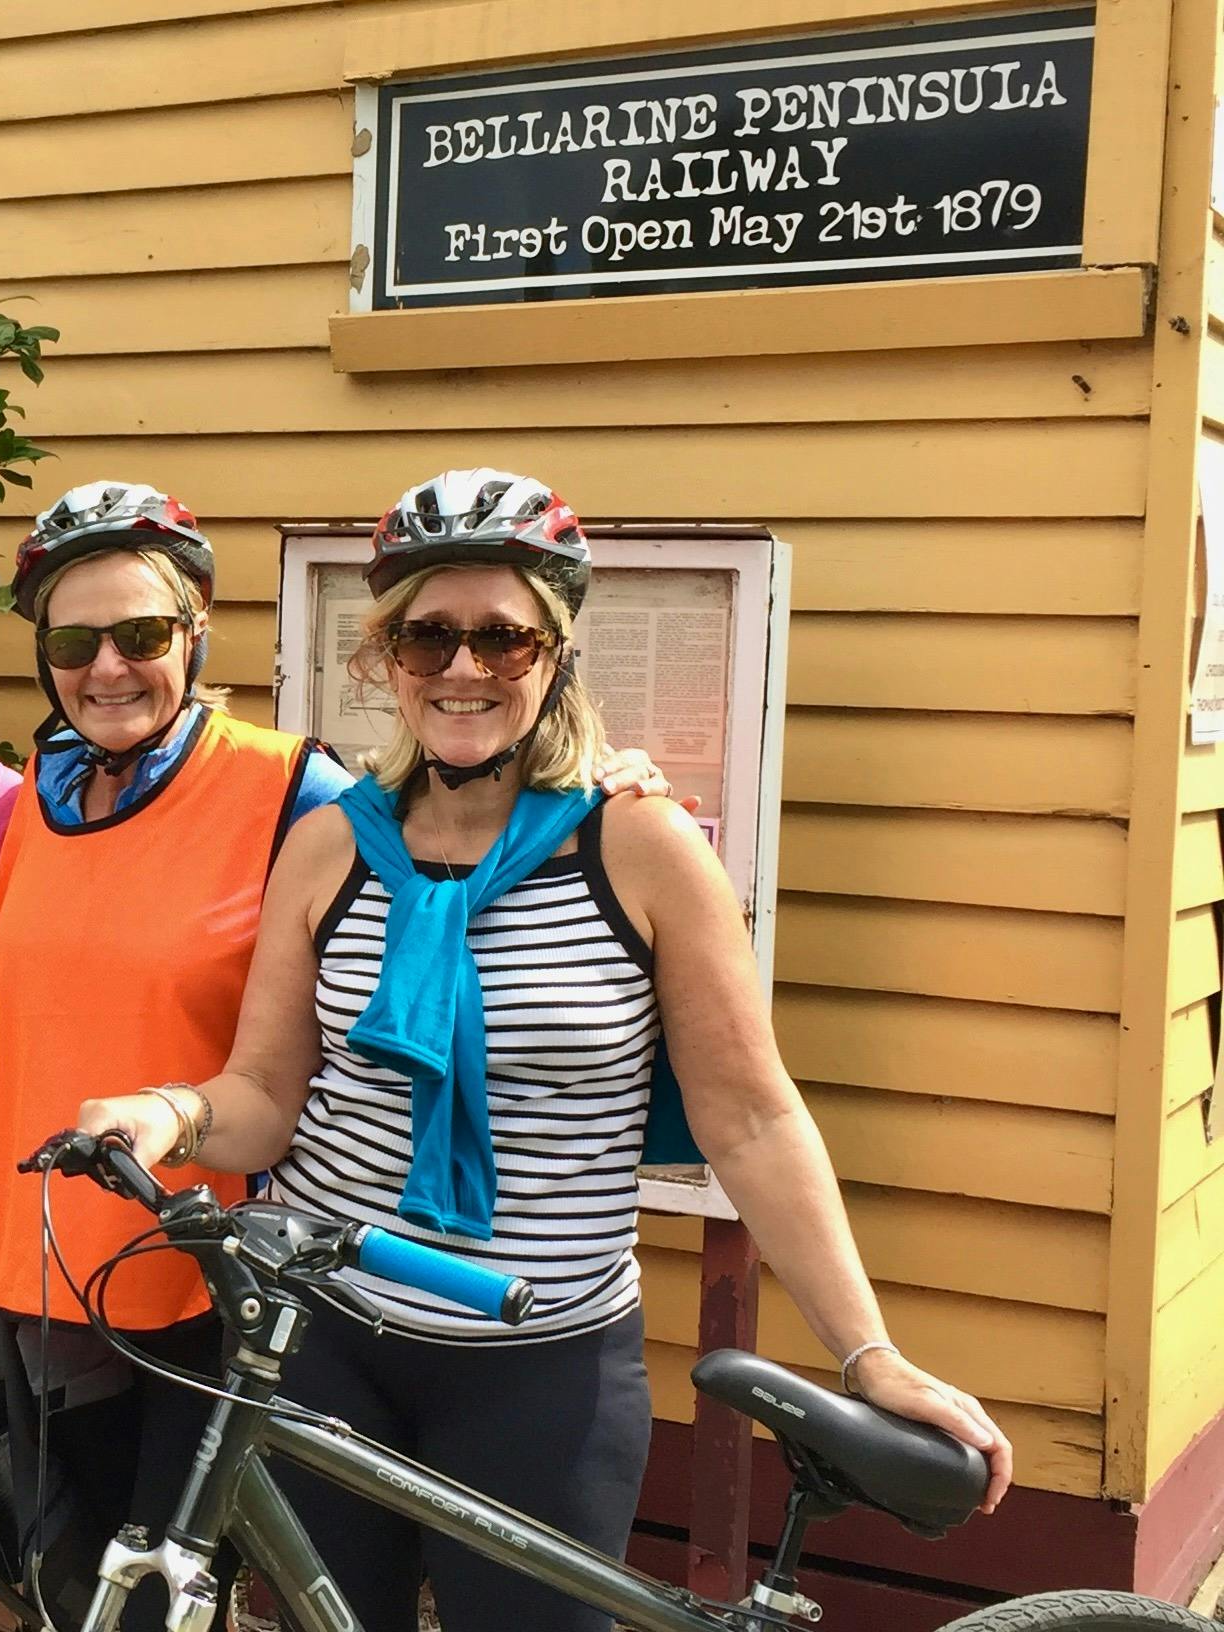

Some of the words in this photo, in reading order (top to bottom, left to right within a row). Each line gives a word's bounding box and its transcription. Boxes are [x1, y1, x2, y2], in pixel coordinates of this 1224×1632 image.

[422, 93, 718, 168] BELLARINE
[733, 60, 1068, 138] PENINSULA
[600, 136, 848, 203] RAILWAY
[444, 217, 569, 262] First
[581, 215, 694, 261] Open
[709, 205, 804, 254] May
[818, 195, 918, 242] 21st
[933, 180, 1042, 235] 1879
[377, 1467, 470, 1519] COMFORT
[474, 1515, 529, 1550] PLUS
